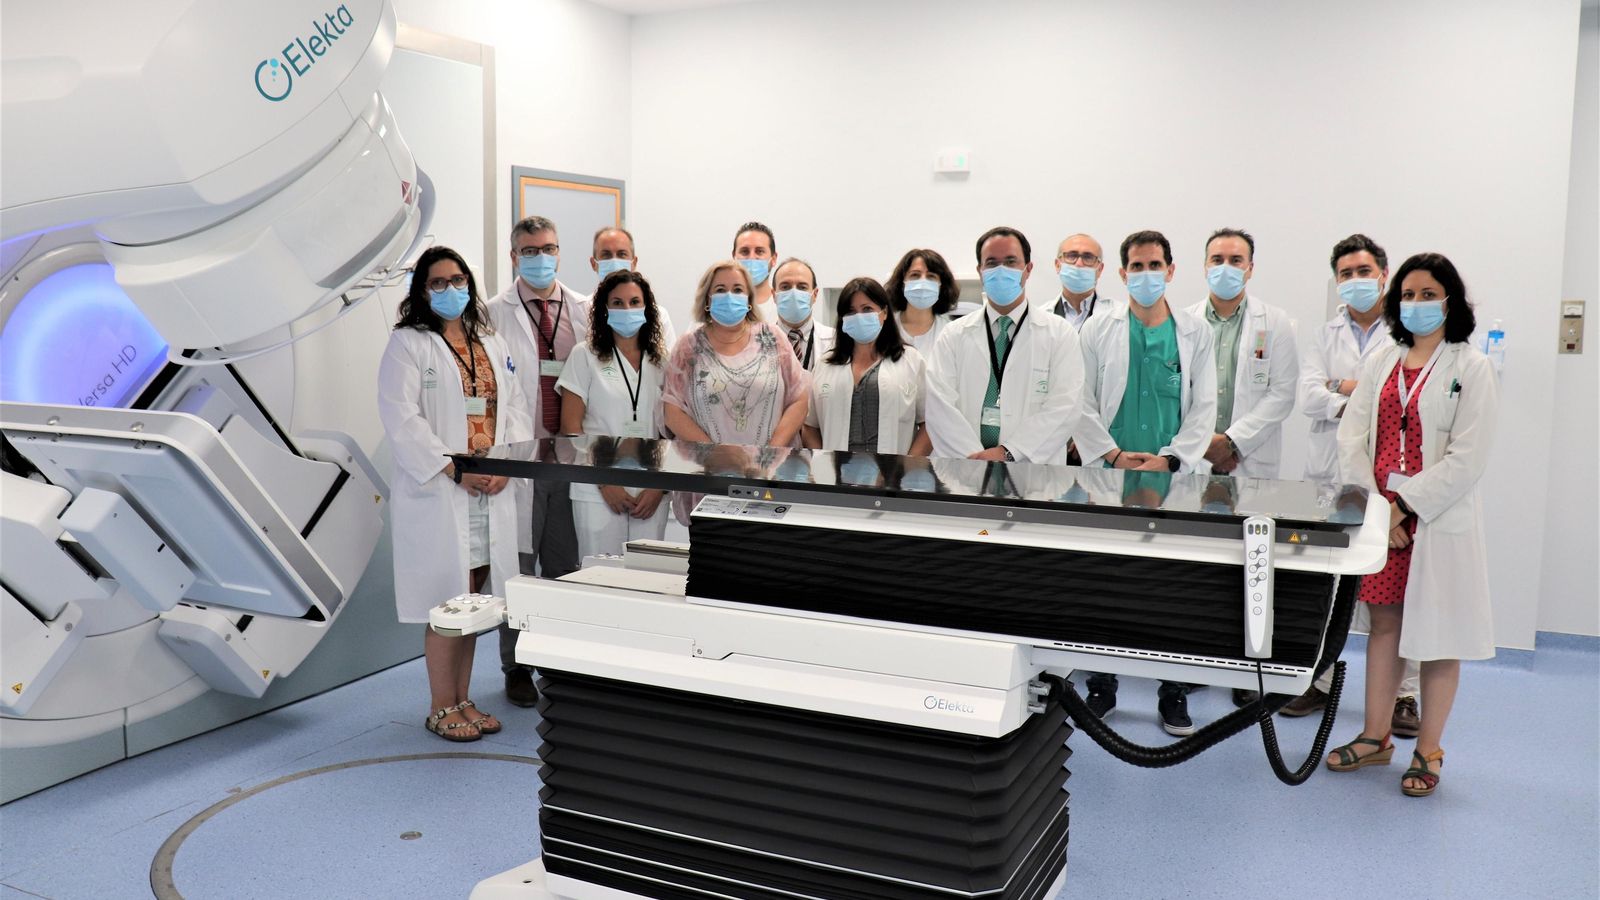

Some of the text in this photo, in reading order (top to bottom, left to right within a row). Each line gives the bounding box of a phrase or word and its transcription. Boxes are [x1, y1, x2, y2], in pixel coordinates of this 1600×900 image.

[281, 4, 354, 77] Elekta
[111, 344, 137, 374] HD
[937, 698, 975, 714] Elekta
